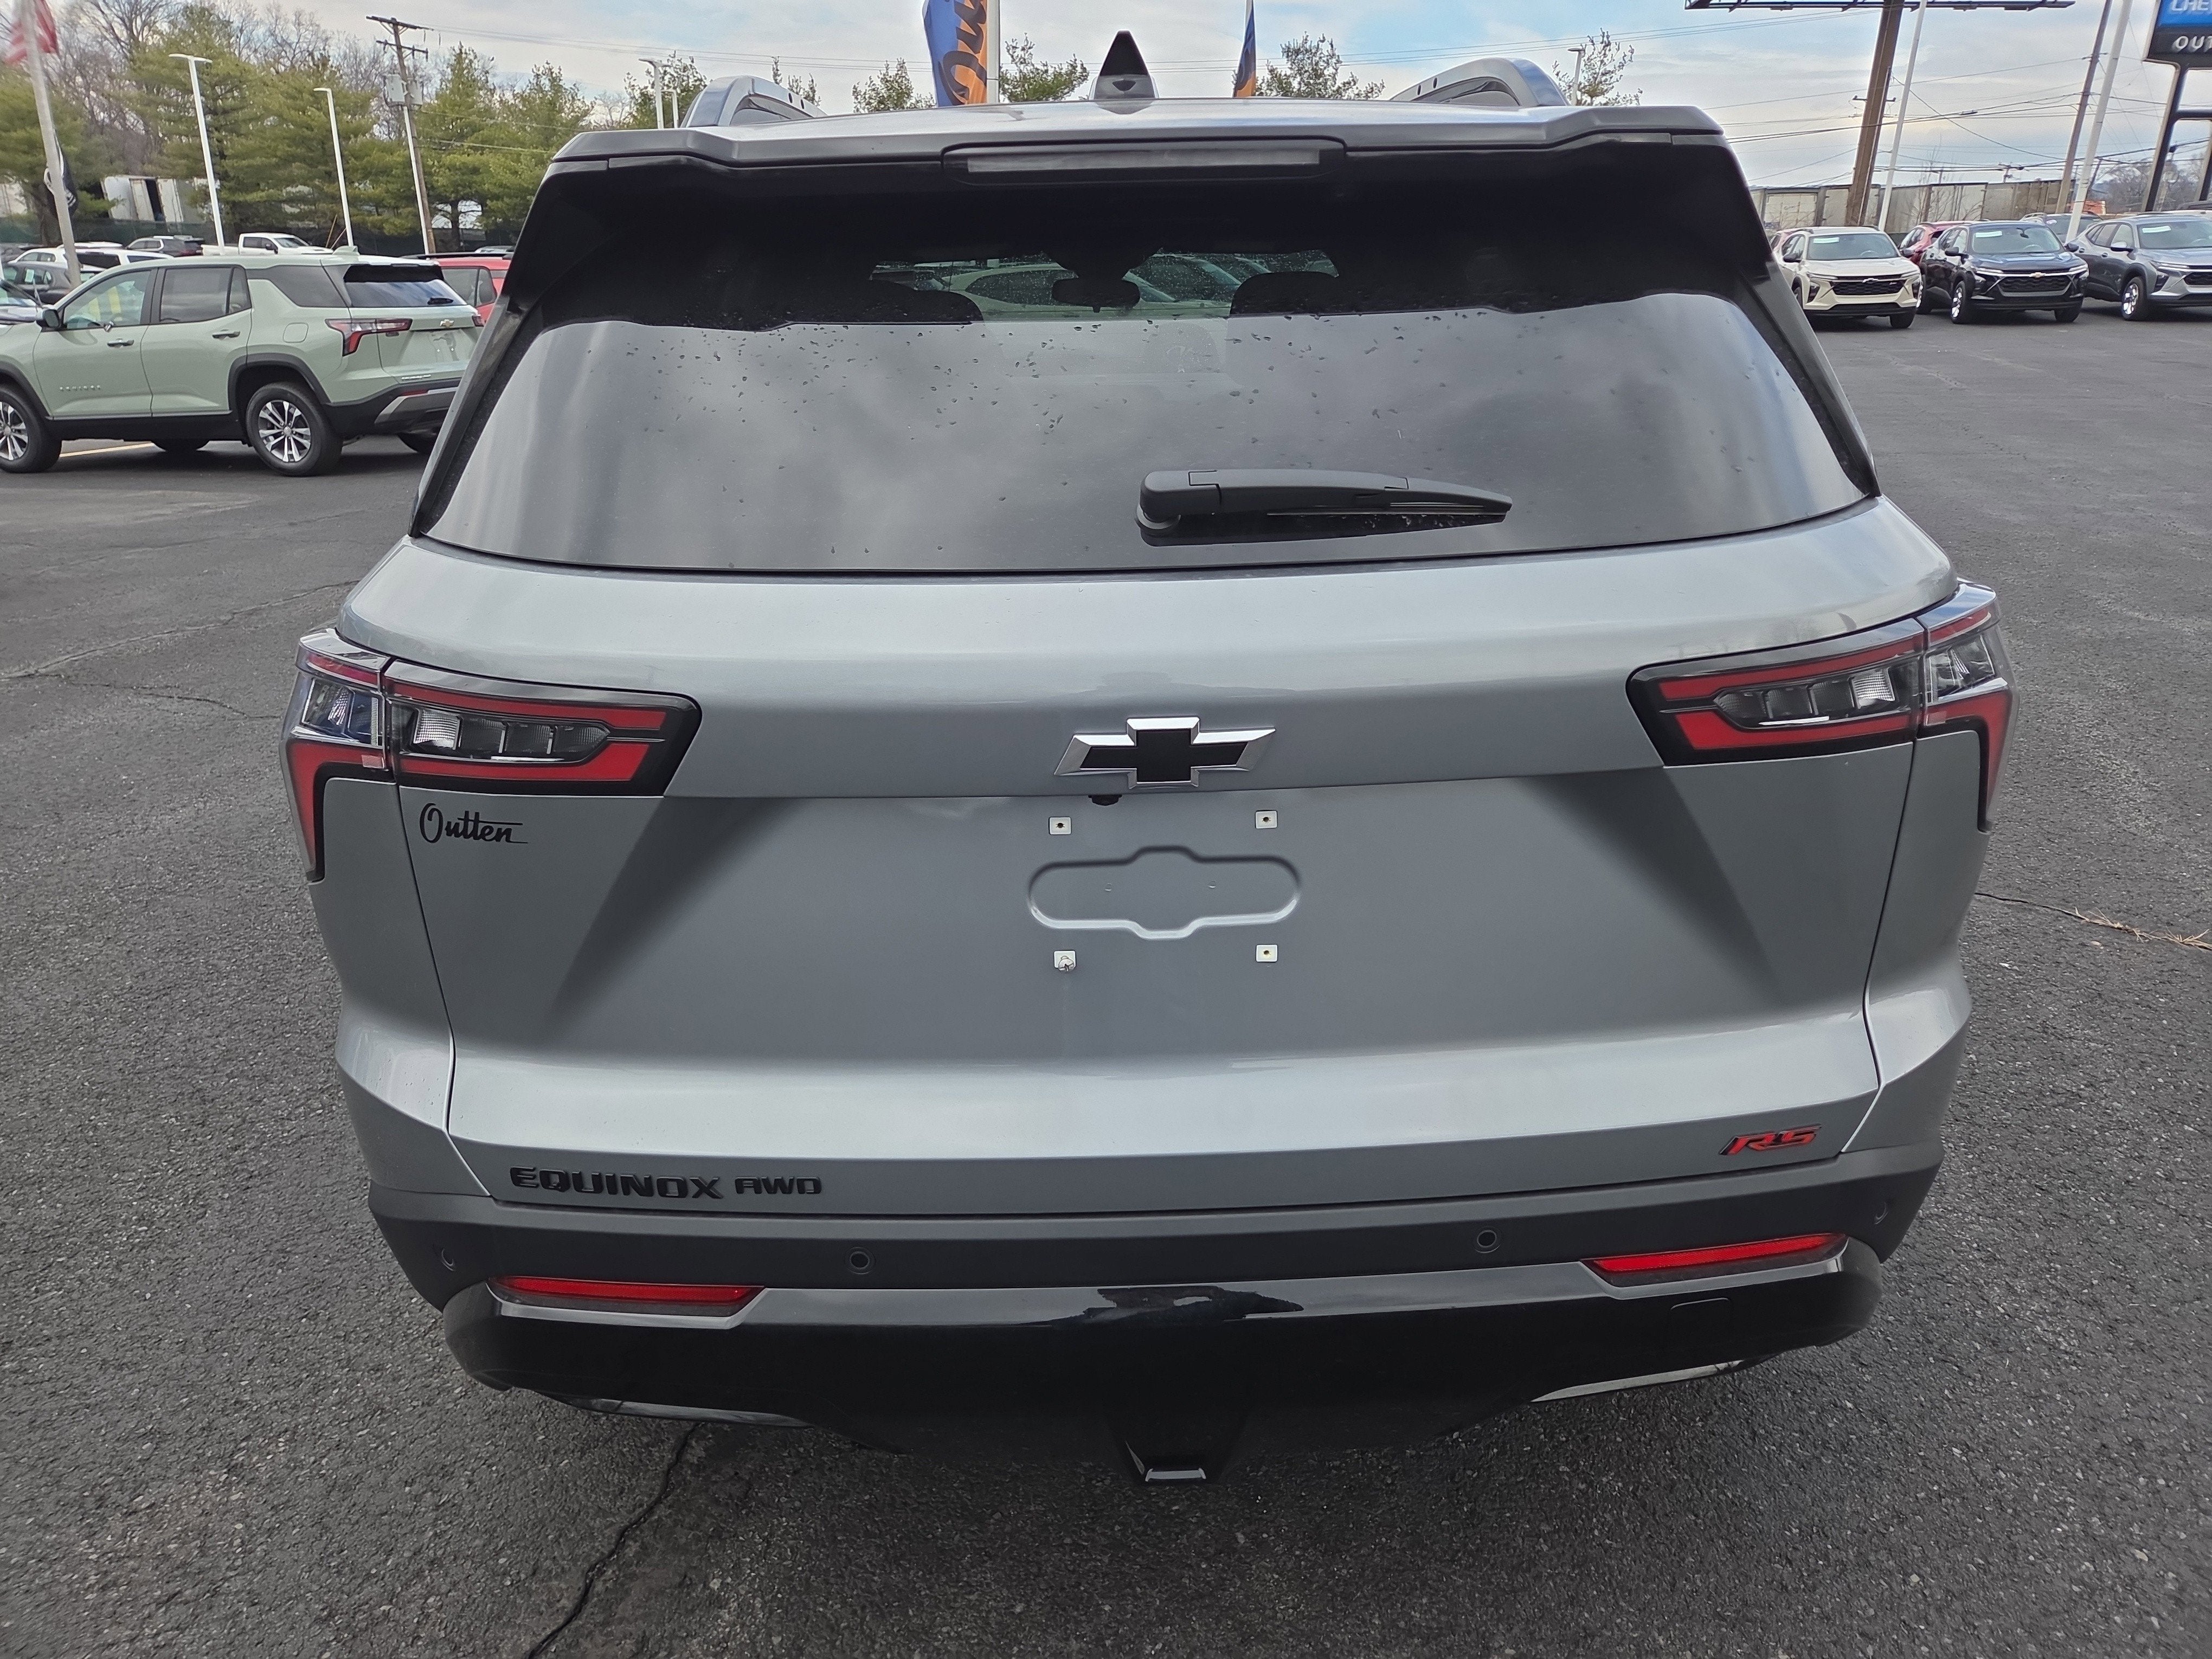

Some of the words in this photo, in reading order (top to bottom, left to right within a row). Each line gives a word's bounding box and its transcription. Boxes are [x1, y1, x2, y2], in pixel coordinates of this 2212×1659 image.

[2170, 0, 2212, 11] CHE
[420, 803, 529, 844] Outten
[1718, 1123, 1822, 1156] RS
[509, 1166, 724, 1199] EQUINOX
[735, 1176, 822, 1195] AWD
